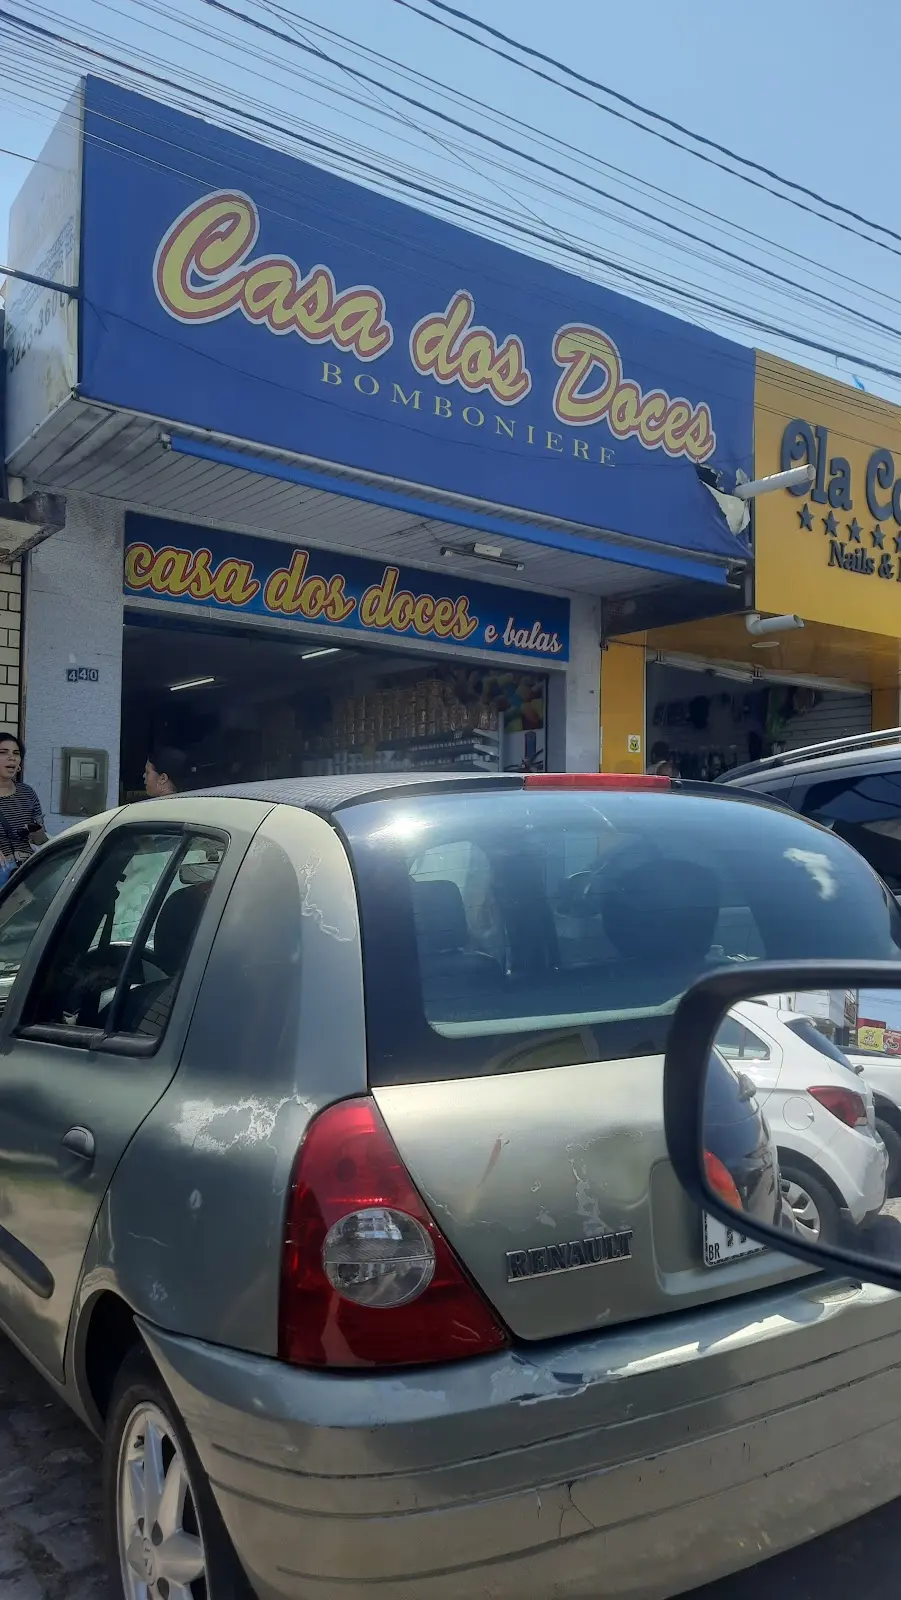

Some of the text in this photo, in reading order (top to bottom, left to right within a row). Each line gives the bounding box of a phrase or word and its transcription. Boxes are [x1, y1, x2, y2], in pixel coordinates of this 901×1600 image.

[153, 189, 393, 361] Casa
[410, 288, 531, 405] dos
[553, 323, 716, 463] Doces
[321, 360, 617, 467] BOMBONIERE
[828, 540, 875, 575] Nails
[878, 553, 894, 579] &
[125, 541, 562, 653] casa dos doces e balas
[67, 668, 98, 682] 440
[506, 1230, 633, 1283] RENAULT
[708, 1243, 721, 1261] BR
